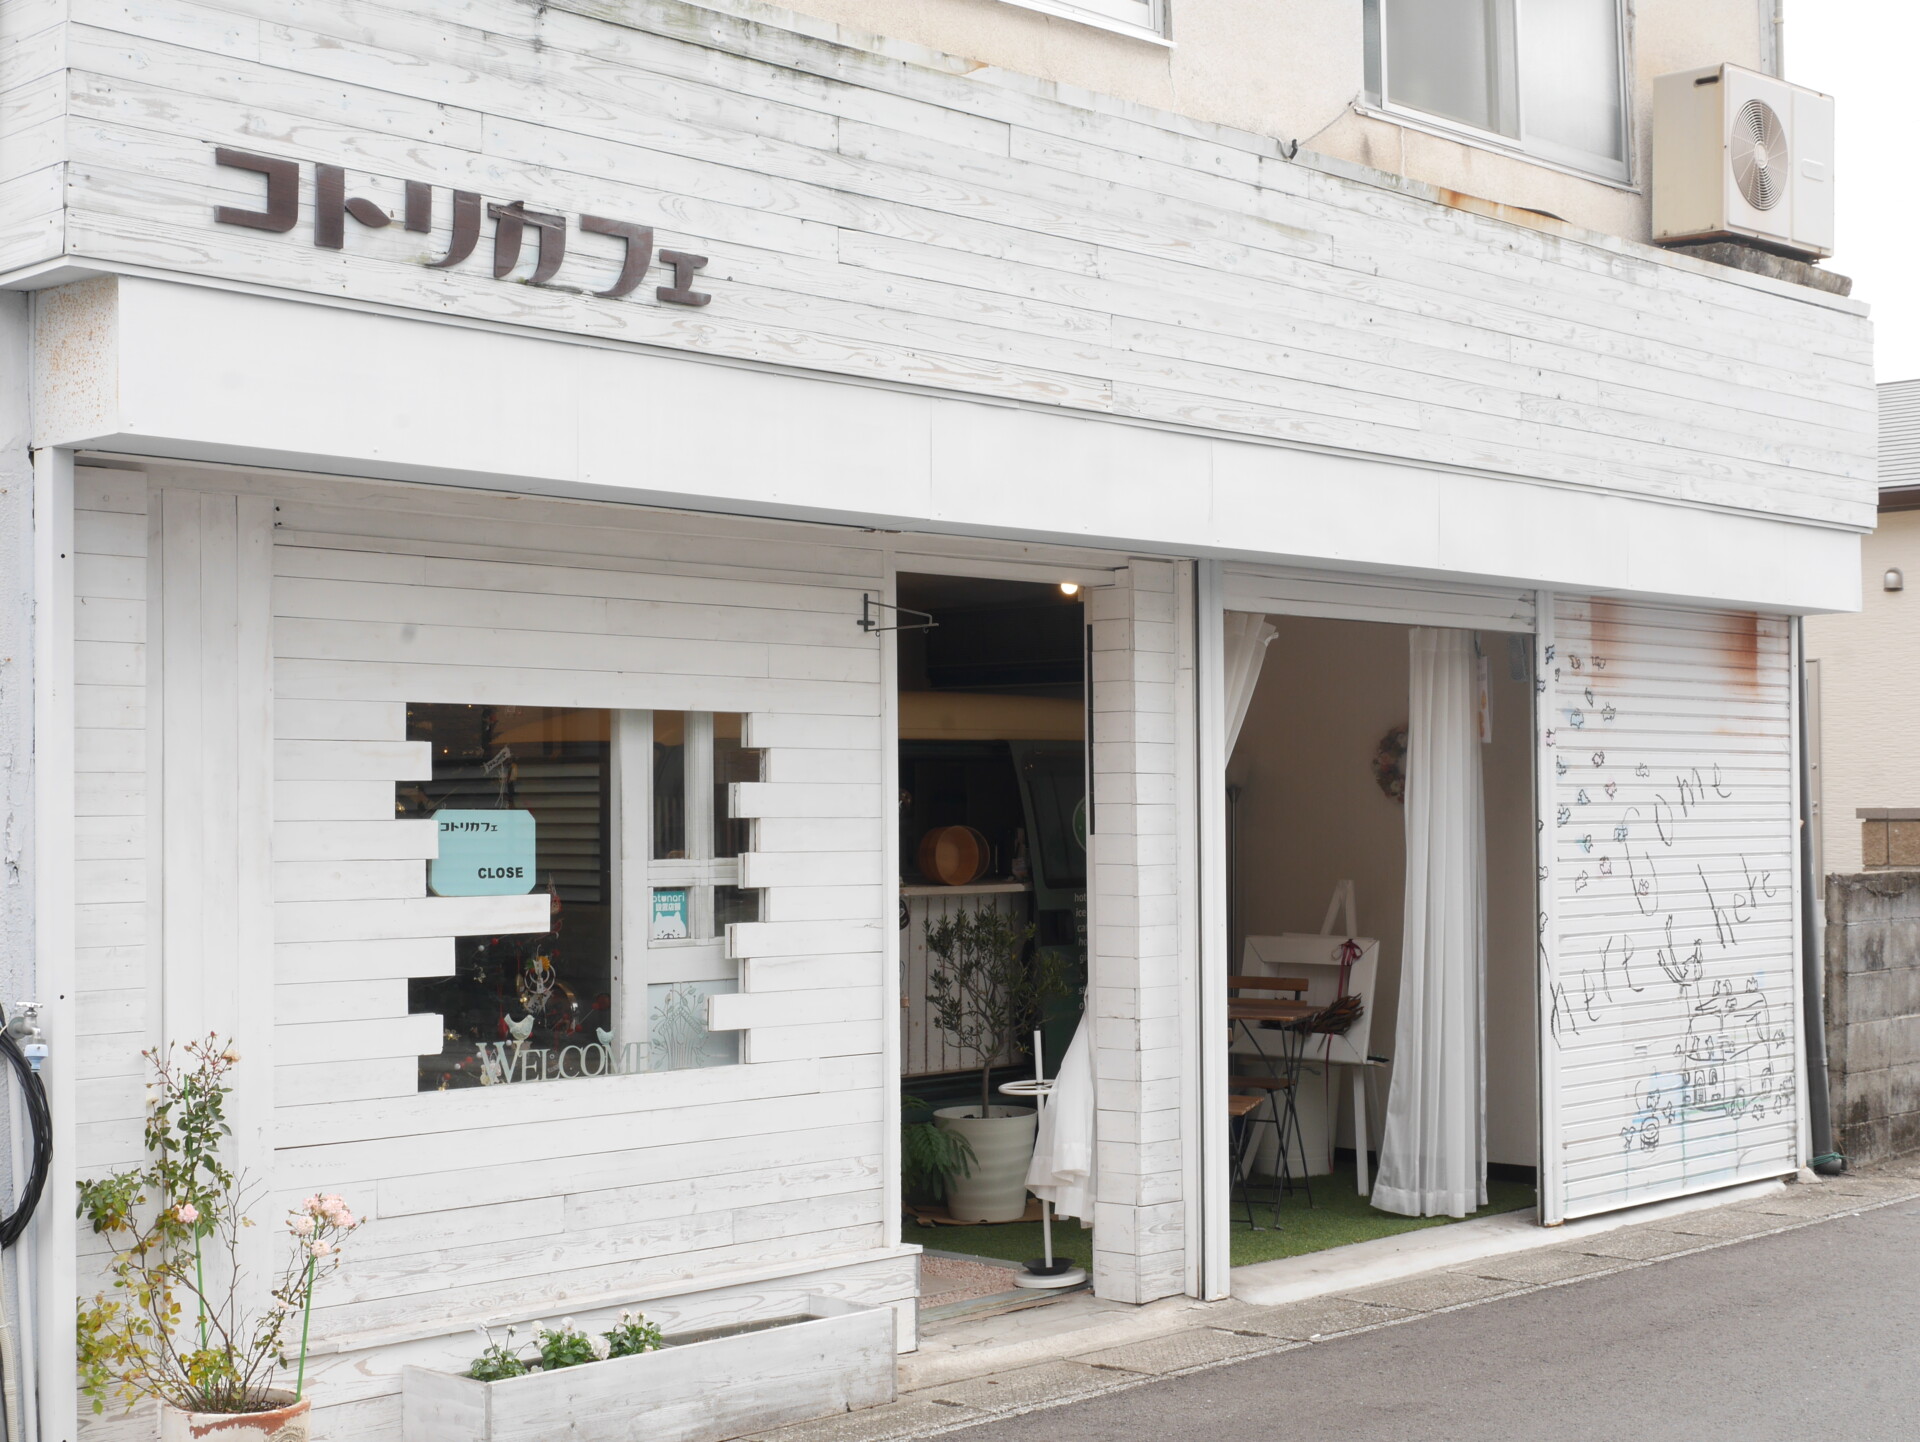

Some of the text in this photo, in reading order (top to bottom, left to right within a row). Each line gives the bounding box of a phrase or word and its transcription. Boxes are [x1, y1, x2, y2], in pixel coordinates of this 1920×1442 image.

[214, 147, 711, 306] コトリカフェ
[440, 821, 498, 832] コトリカフェ
[478, 866, 524, 879] CLOSE
[476, 1041, 651, 1086] WELCOME
